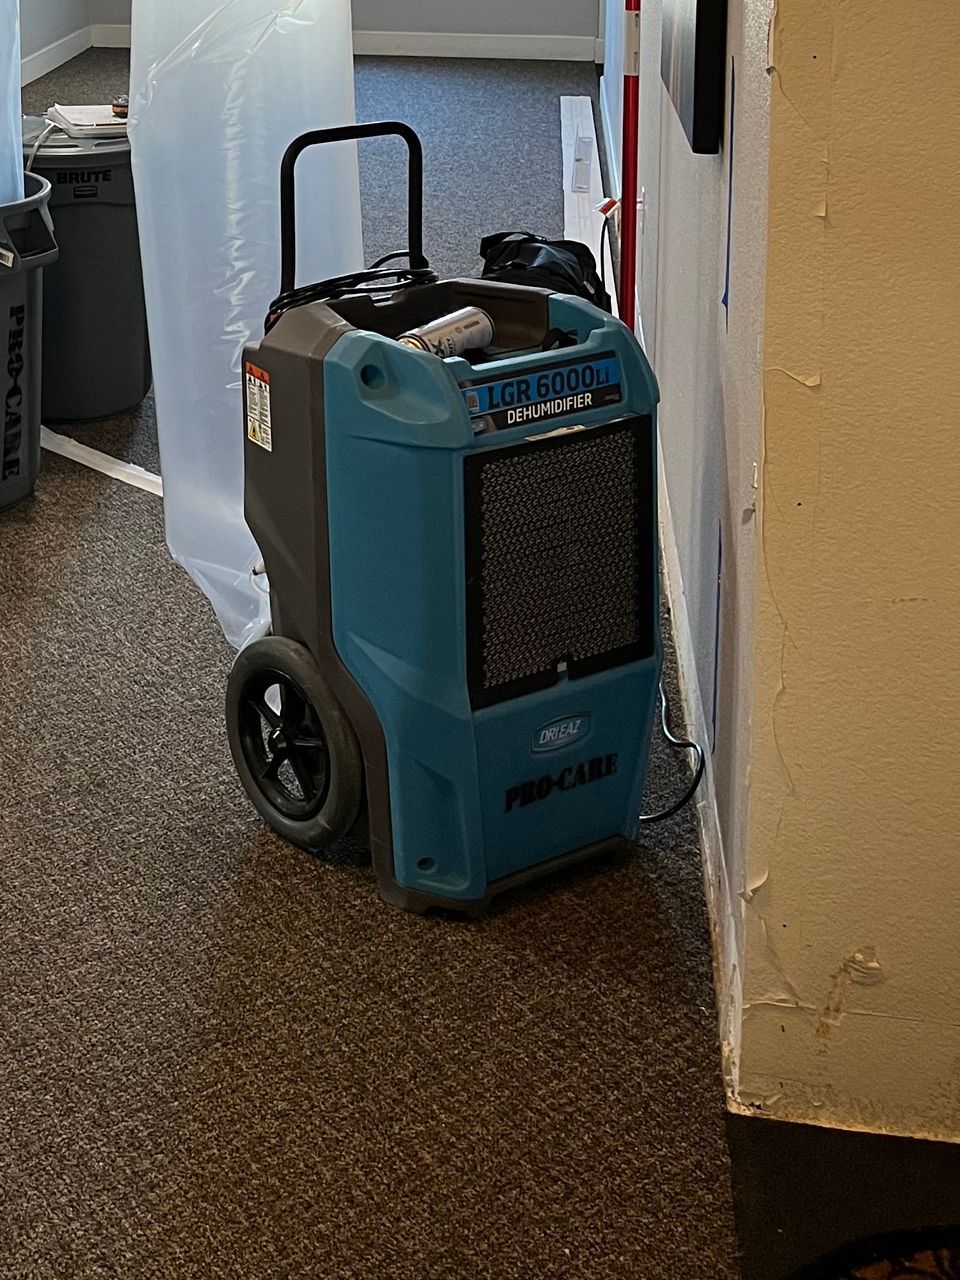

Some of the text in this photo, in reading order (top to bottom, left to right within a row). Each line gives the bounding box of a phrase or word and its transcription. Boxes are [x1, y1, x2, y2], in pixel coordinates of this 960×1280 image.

[56, 170, 112, 185] BRUTE
[488, 378, 531, 409] LGR
[507, 392, 593, 425] DEHUMIDIFIER
